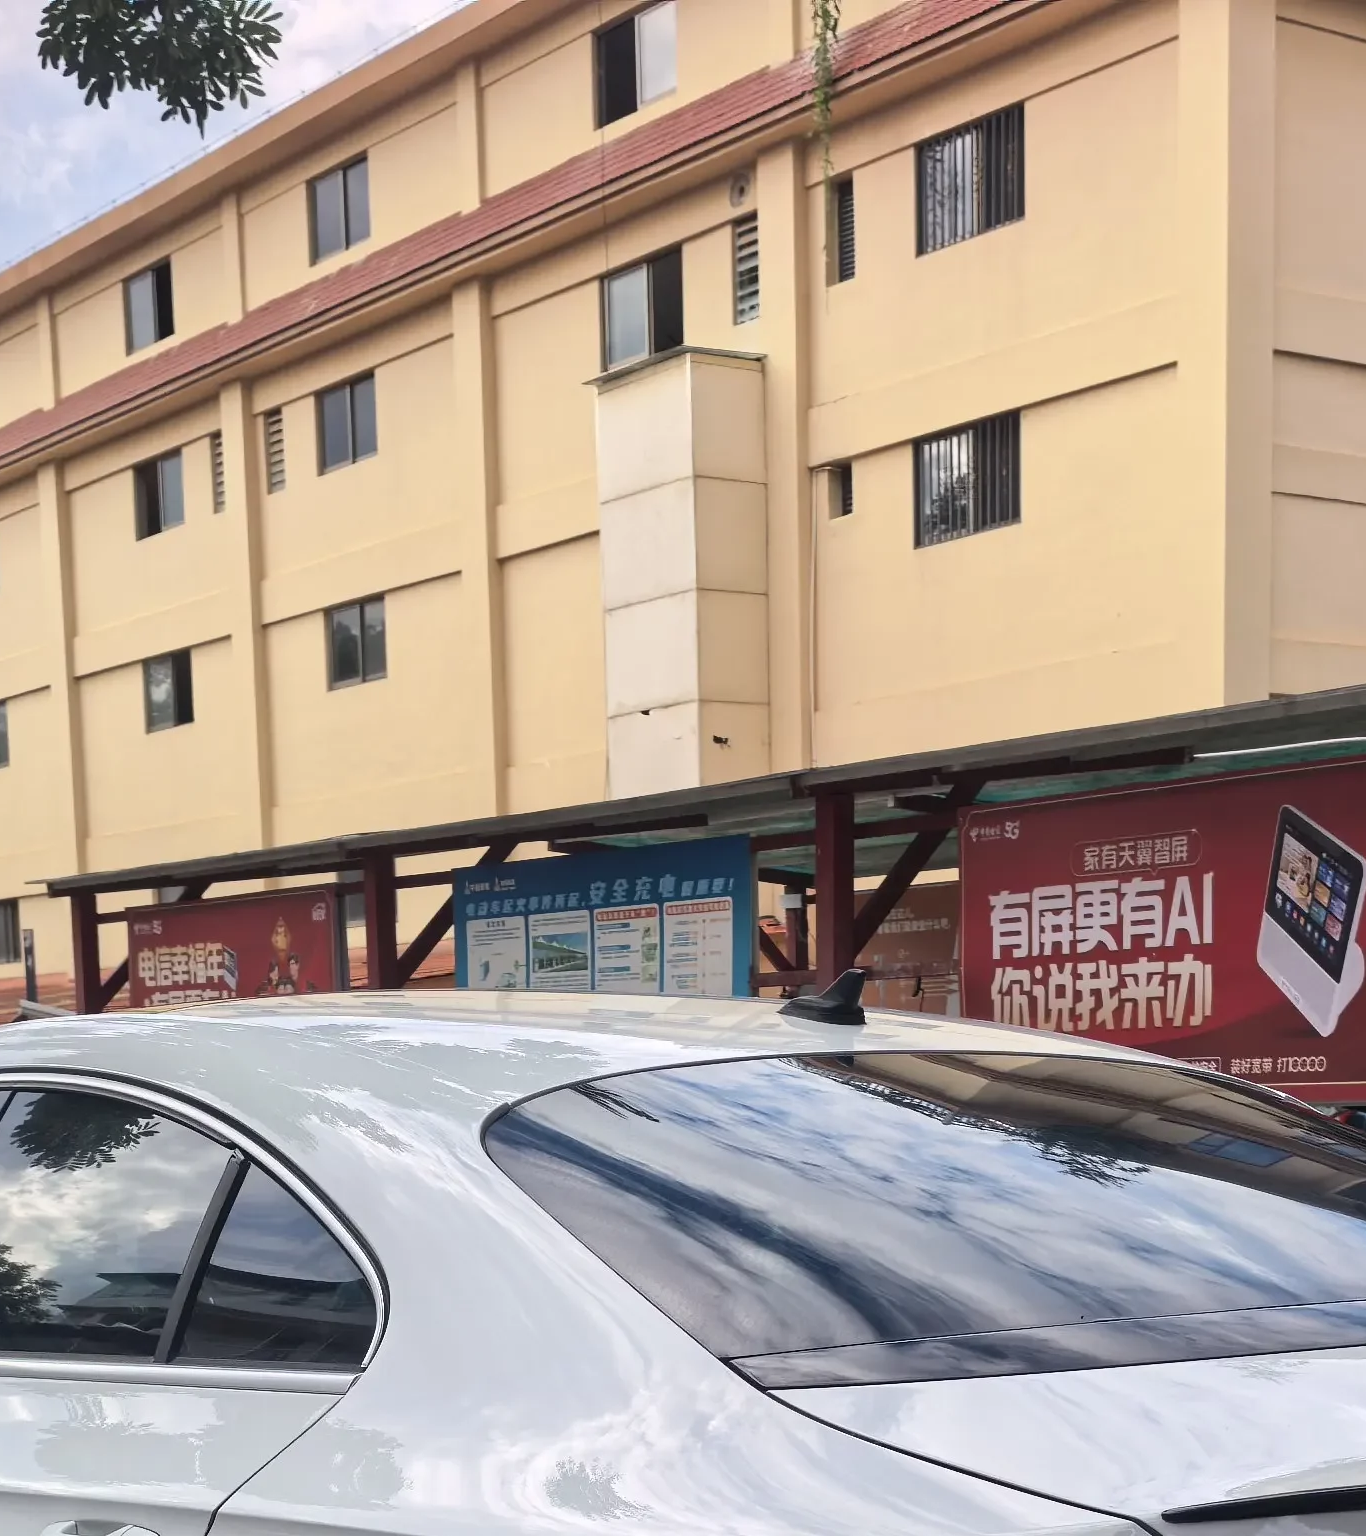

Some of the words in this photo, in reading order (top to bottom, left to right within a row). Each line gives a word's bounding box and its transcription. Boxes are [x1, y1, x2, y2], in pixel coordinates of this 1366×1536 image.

[1083, 835, 1189, 872] 家有天翼智屏
[989, 871, 1215, 960] 有屏更有AI
[138, 942, 225, 987] 电信幸福年
[990, 953, 1213, 1032] 你说我来办
